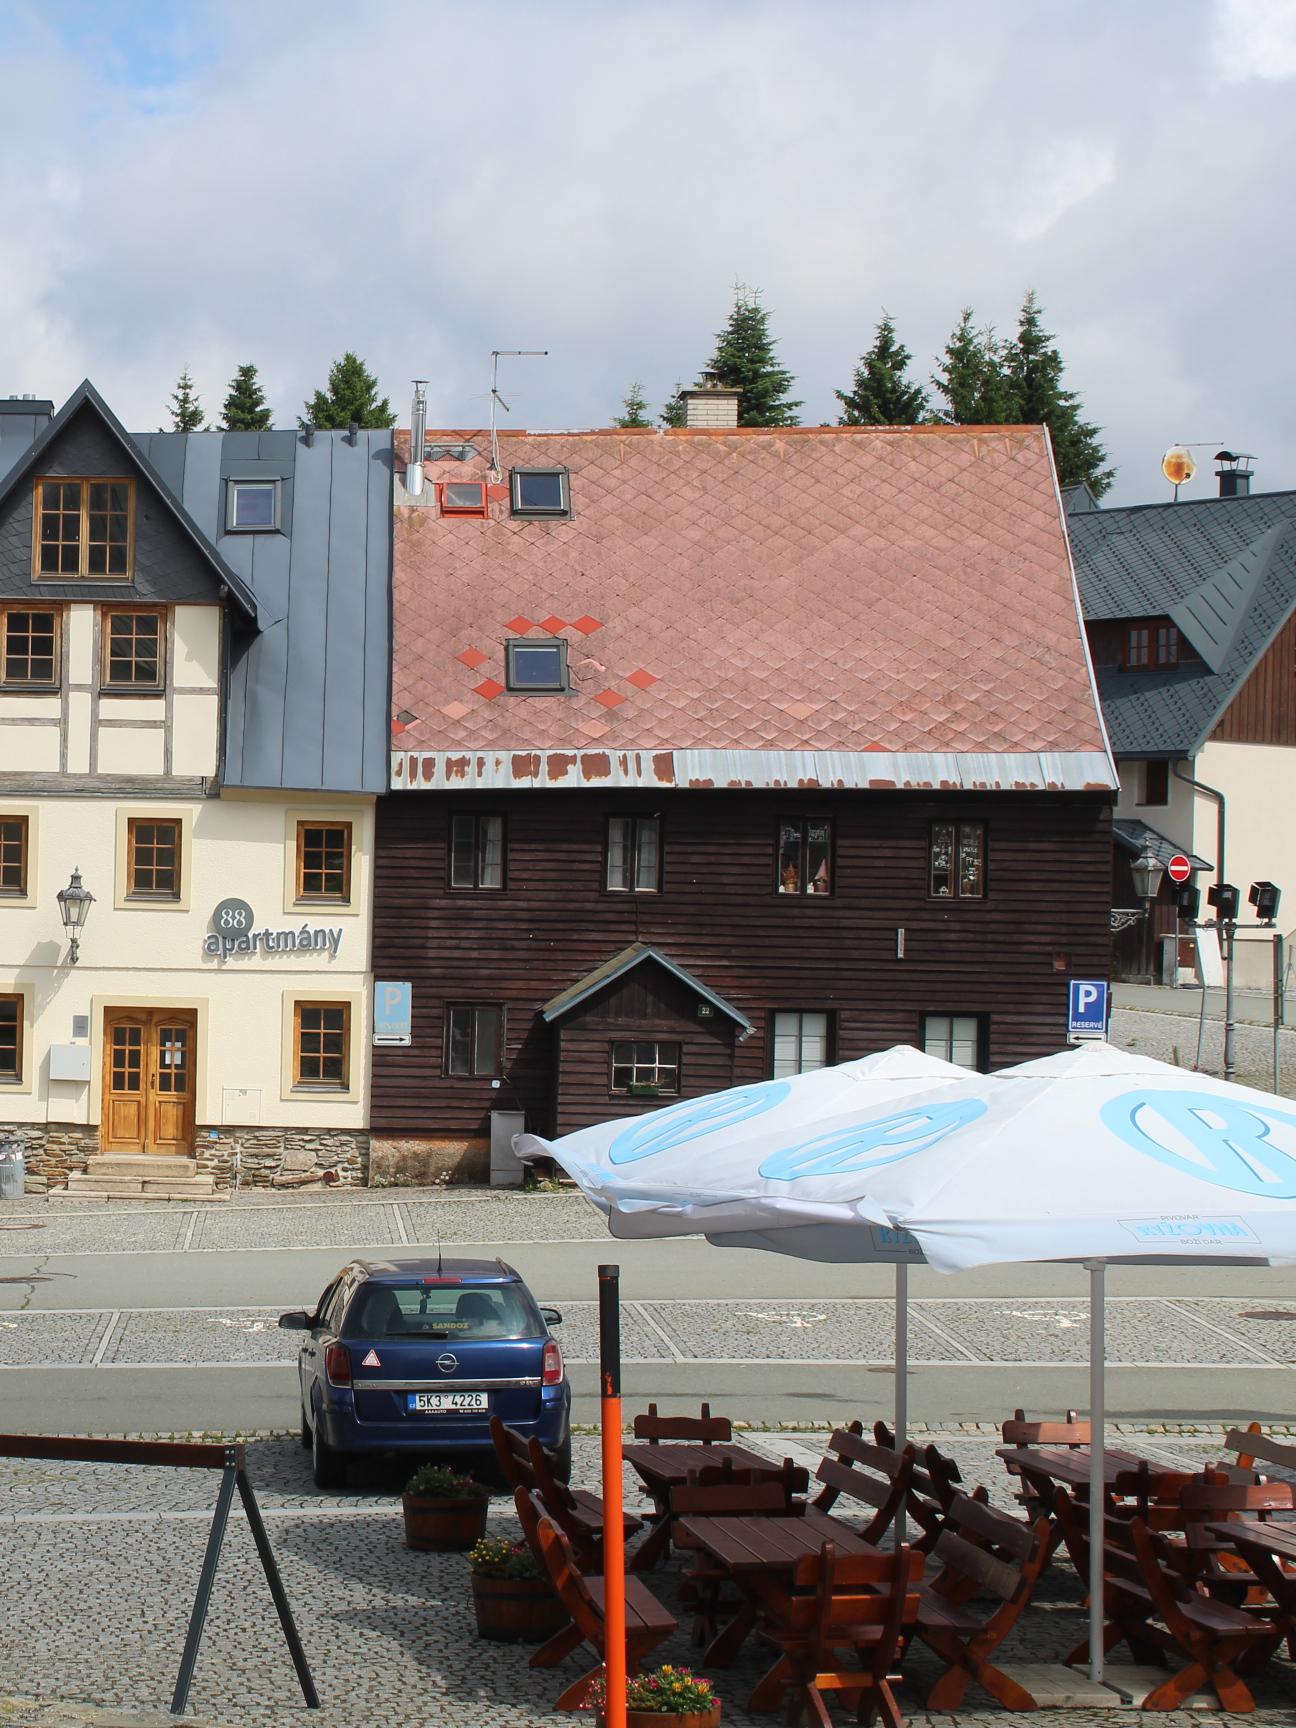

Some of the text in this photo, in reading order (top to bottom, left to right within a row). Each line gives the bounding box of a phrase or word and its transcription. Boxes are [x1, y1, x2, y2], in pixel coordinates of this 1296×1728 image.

[220, 908, 246, 929] 88
[205, 923, 343, 960] apartmány
[385, 988, 402, 1016] P
[1078, 984, 1098, 1013] P
[418, 1395, 442, 1408] 5K3
[451, 1394, 482, 1407] 4226
